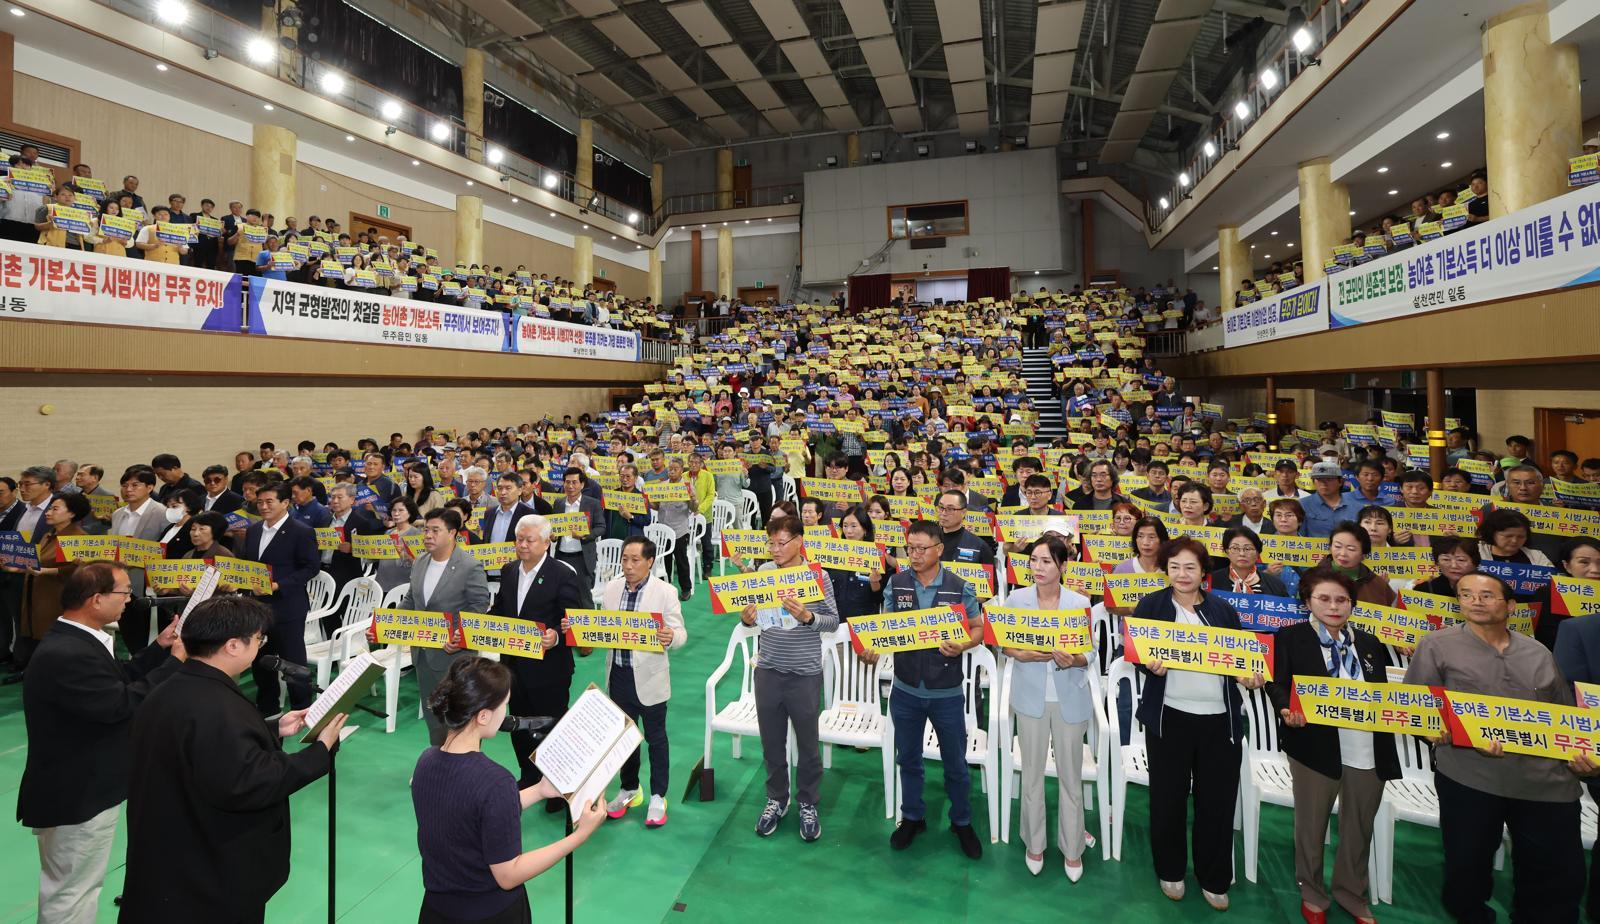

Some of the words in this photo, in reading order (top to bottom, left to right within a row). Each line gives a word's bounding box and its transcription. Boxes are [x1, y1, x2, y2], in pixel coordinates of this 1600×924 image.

[1339, 283, 1345, 305] 전
[1346, 274, 1364, 303] 군민의
[1366, 268, 1386, 299] 생존권
[1388, 263, 1406, 295] 보장,
[1408, 254, 1434, 289] 농어촌
[1436, 240, 1478, 281] 기본소득
[1480, 235, 1492, 270] 더
[1495, 227, 1520, 266] 이상
[1525, 215, 1554, 258] 미룰
[1558, 211, 1574, 251] 수
[29, 257, 97, 295] 기본소득
[102, 267, 160, 302] 시범사업
[165, 275, 191, 304] 무주
[195, 279, 223, 309] 유치!
[1413, 290, 1445, 309] 설천면민
[1448, 286, 1465, 301] 일동
[272, 290, 295, 316] 지역
[299, 294, 350, 321] 균형발전의
[353, 301, 380, 324] 첫걸음
[383, 304, 408, 327] 농어촌
[410, 308, 442, 331] 기본소득,
[444, 312, 470, 333] 무주에서
[472, 314, 499, 337] 보여주자!
[382, 330, 412, 342] 무주읍민
[415, 333, 428, 343] 일동
[1409, 513, 1439, 521] 기본소득
[1525, 509, 1561, 519] 기본소득
[1183, 529, 1211, 538] 기본소득
[1396, 522, 1435, 531] 자연특별시
[1438, 524, 1464, 533] 무주로
[1557, 523, 1588, 534] 무주로
[723, 533, 741, 542] 농어촌
[875, 533, 895, 542] 무주로
[1085, 539, 1105, 547] 농어촌
[734, 546, 765, 554] 자연특별시
[804, 539, 822, 548] 농어촌
[825, 542, 849, 552] 기본소득
[852, 545, 883, 556] 시범사업을
[1281, 540, 1312, 550] 기본소득
[814, 554, 846, 565] 자연특별시
[848, 557, 870, 568] 무주로
[872, 560, 880, 570] !!!
[1098, 552, 1132, 560] 자연특별시
[1268, 552, 1308, 562] 자연특별시
[1384, 552, 1416, 561] 기본소득
[157, 564, 178, 572] 기본소득
[233, 563, 250, 572] 기본소득
[955, 568, 990, 578] 시범사업을
[1373, 565, 1413, 575] 자연특별시
[1477, 565, 1513, 575] 농어촌
[176, 574, 197, 584] 무주로
[223, 574, 248, 585] 자연특별시
[250, 577, 265, 588] 무주로
[712, 581, 738, 592] 농어촌
[742, 575, 776, 589] 기본소득
[779, 569, 818, 585] 시범사업을
[1065, 578, 1092, 590] 무주로
[1108, 579, 1130, 588] 농어촌
[1134, 578, 1165, 587] 기본소득
[731, 592, 773, 606] 자연특별시
[776, 588, 806, 601] 무주로
[809, 585, 819, 596] !!!
[980, 584, 988, 593] !!!
[1557, 582, 1594, 596] 농어촌
[1254, 600, 1309, 614] 기본소득은
[1402, 594, 1435, 610] 농어촌
[375, 614, 394, 624] 농어촌
[396, 615, 419, 625] 기본소득
[422, 617, 450, 628] 시범사업을
[461, 618, 480, 629] 농어촌
[483, 620, 510, 632] 기본소득
[513, 624, 544, 637] 시범사업을
[568, 615, 590, 625] 농어촌
[593, 616, 622, 627] 기본소득
[625, 617, 660, 629] 시범사업을
[852, 622, 878, 634] 농어촌
[882, 617, 916, 630] 기본소득
[920, 611, 963, 626] 시범사업을
[987, 612, 1016, 625] 농어촌
[1021, 616, 1060, 629] 기본소득
[1387, 612, 1438, 632] 시범사업을
[383, 629, 415, 641] 자연특별시
[416, 630, 438, 642] 무주로
[440, 634, 448, 644] !!!
[582, 631, 619, 642] 자연특별시
[621, 632, 647, 644] 무주로
[650, 636, 659, 646] !!!
[871, 634, 916, 648] 자연특별시
[918, 630, 950, 644] 무주로
[953, 628, 964, 640] !!!
[1005, 631, 1055, 647] 자연특별시
[1059, 633, 1085, 648] 무주로
[1128, 624, 1161, 640] 농어촌
[1165, 628, 1209, 645] 기본소득
[1213, 635, 1269, 654] 시범사업을
[1379, 626, 1416, 644] 무주로
[471, 635, 506, 648] 자연특별시
[507, 638, 530, 651] 무주로
[532, 642, 542, 653] !!!
[1149, 647, 1203, 665] 자연특별시
[1207, 653, 1246, 670] 무주로
[1251, 659, 1264, 674] !!!
[1296, 682, 1330, 698] 농어촌
[1335, 685, 1383, 704] 기본소득
[1387, 690, 1444, 710] 시범사업을
[1315, 704, 1377, 724] 자연특별시
[1380, 710, 1422, 728] 무주로
[1427, 716, 1440, 730] !!!
[1452, 700, 1490, 718] 농어촌
[1495, 704, 1552, 726] 기본소득
[1480, 726, 1548, 749] 자연특별시
